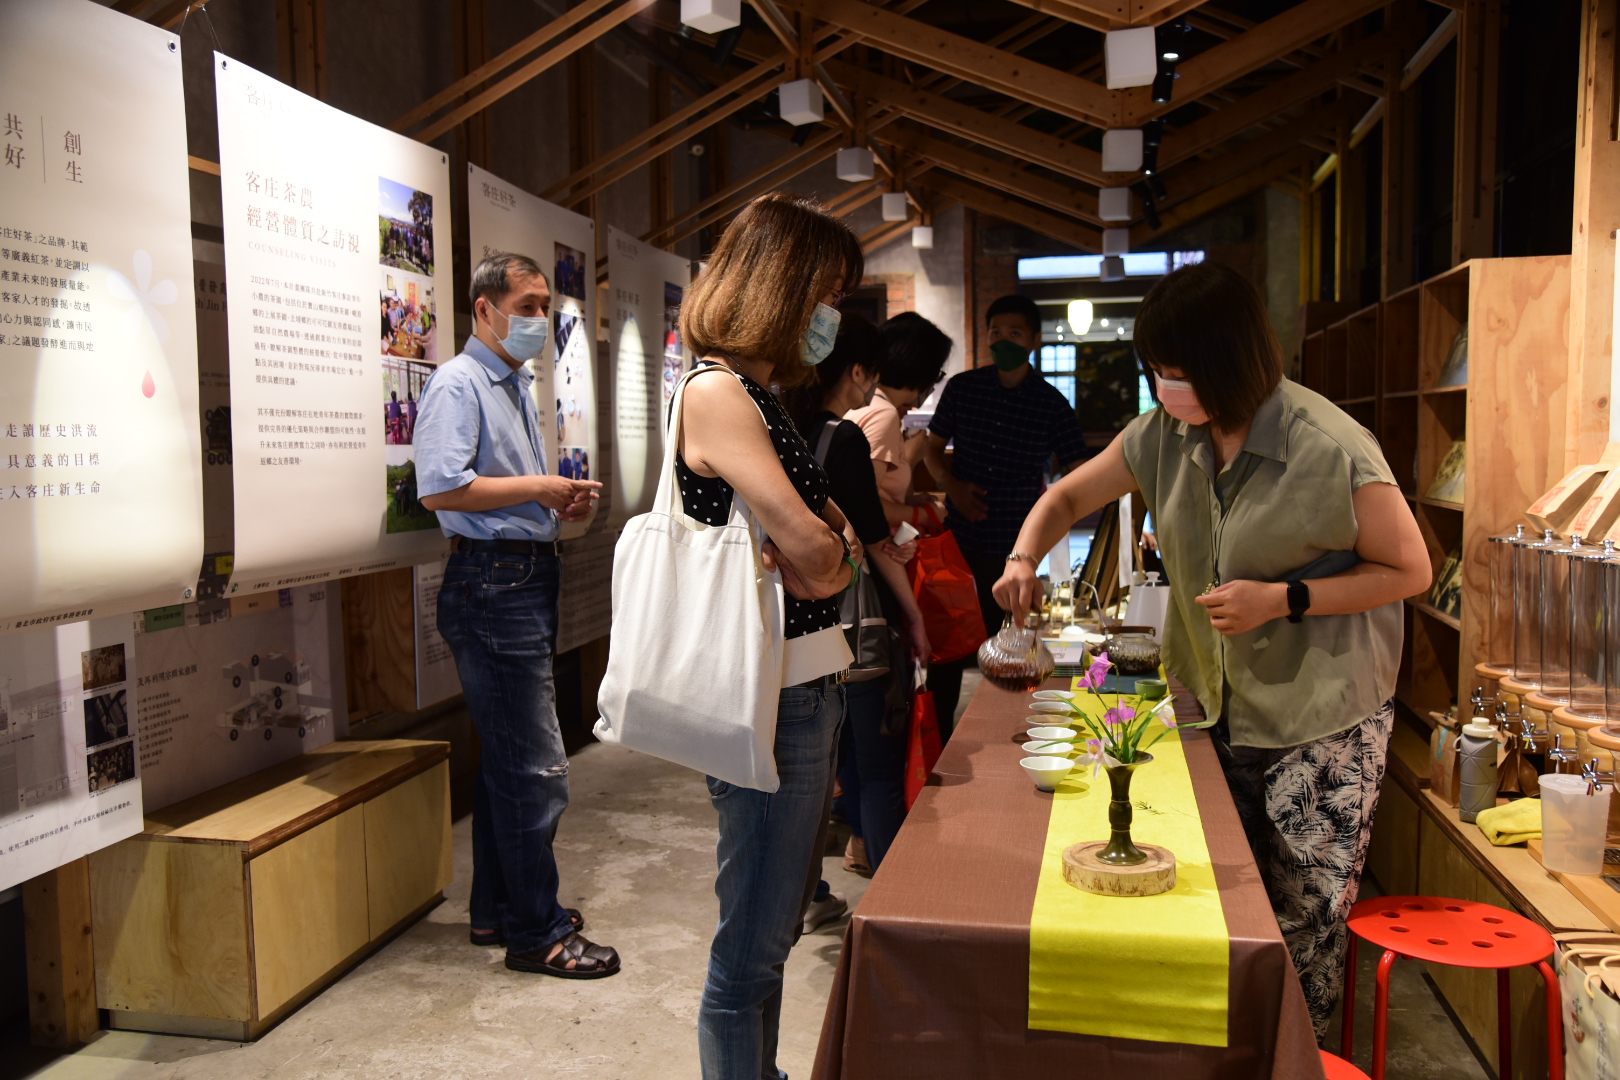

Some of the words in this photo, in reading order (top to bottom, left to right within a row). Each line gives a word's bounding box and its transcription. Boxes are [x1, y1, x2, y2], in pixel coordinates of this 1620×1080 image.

[3, 112, 26, 170] 共好
[63, 130, 83, 184] 創生
[245, 171, 314, 210] 客庄茶農
[481, 181, 517, 208] 客庄好茶
[247, 204, 360, 254] 經營體質之訪視
[248, 240, 306, 262] COUNSELING
[310, 254, 337, 269] VISITS
[5, 423, 98, 438] 走讀歷史洪流
[7, 452, 100, 469] 具意義的目標
